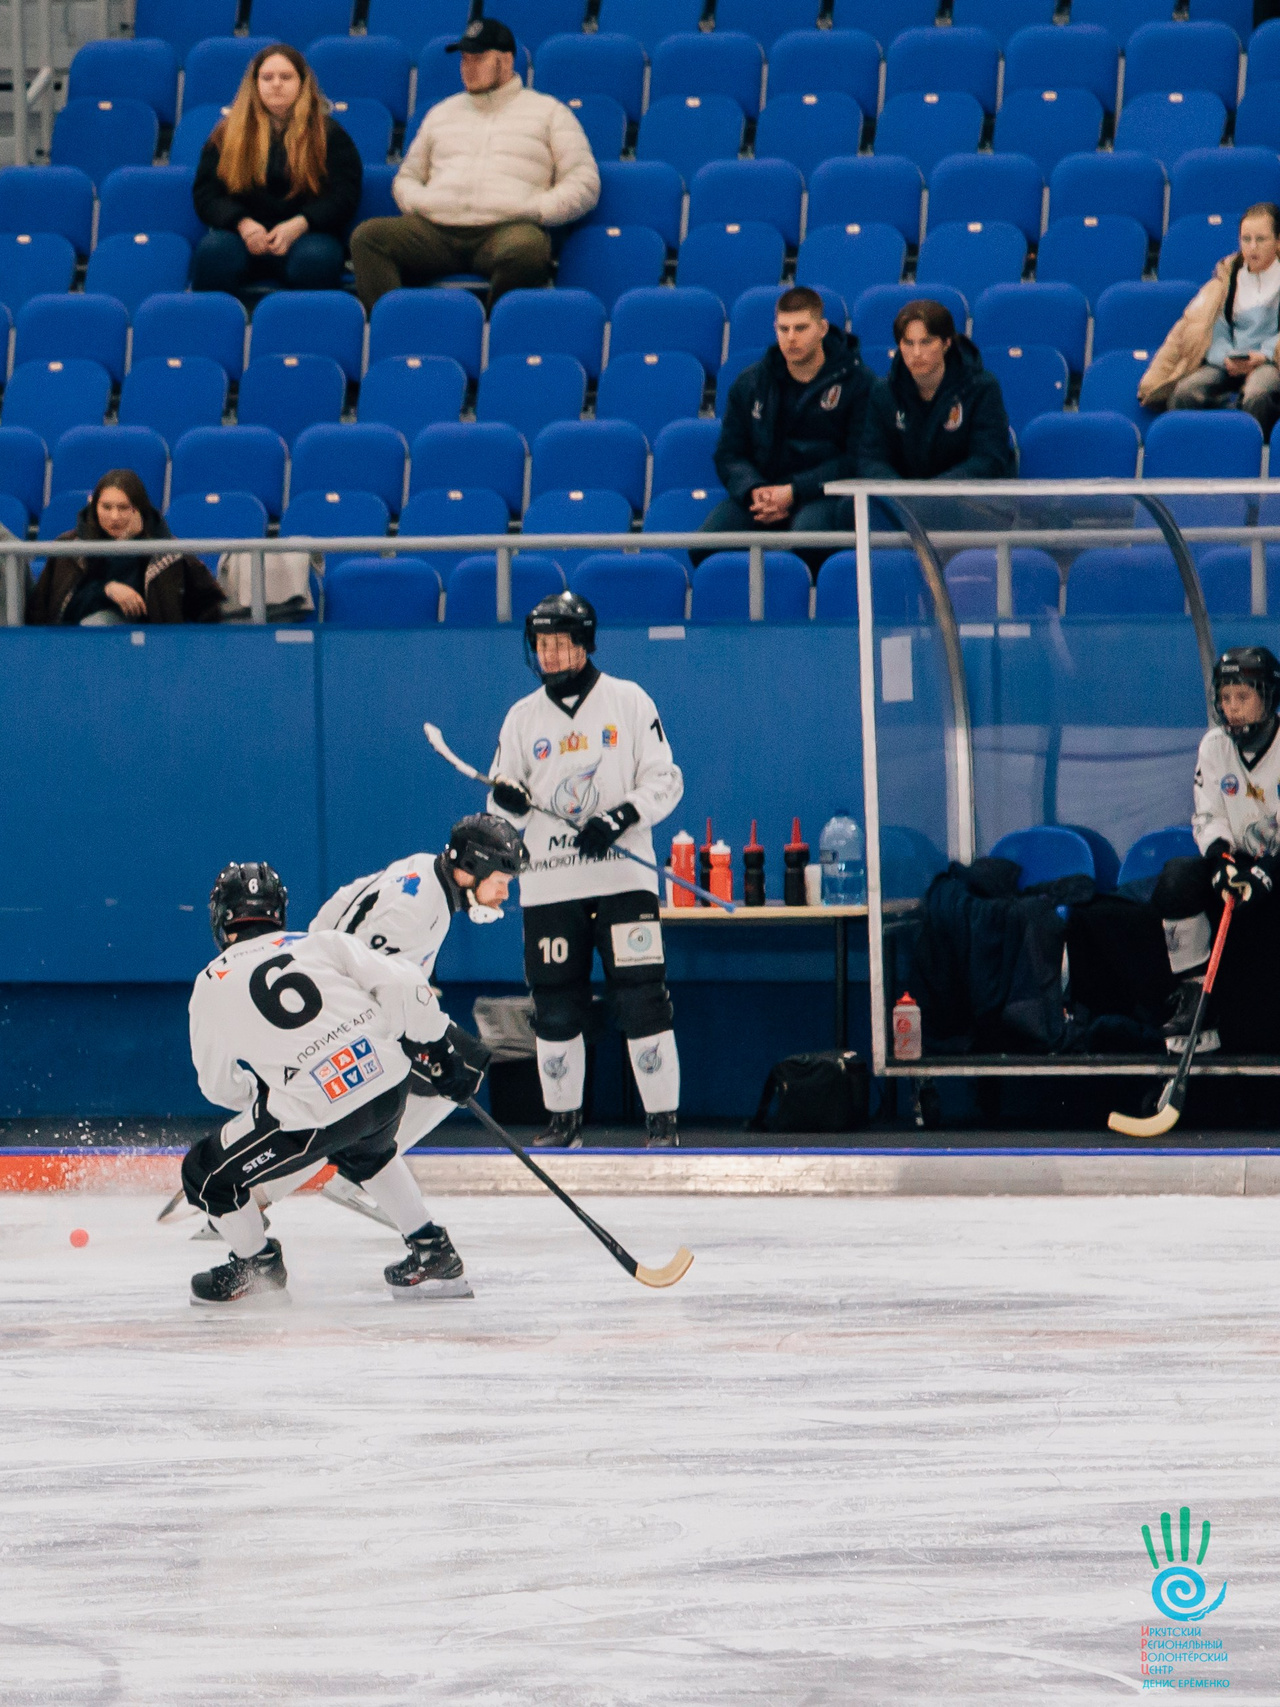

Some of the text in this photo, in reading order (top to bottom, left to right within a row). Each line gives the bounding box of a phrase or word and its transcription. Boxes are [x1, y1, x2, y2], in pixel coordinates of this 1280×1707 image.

[248, 878, 259, 895] 6
[538, 937, 569, 964] 10
[248, 953, 324, 1030] 6
[242, 1148, 277, 1174] STEX
